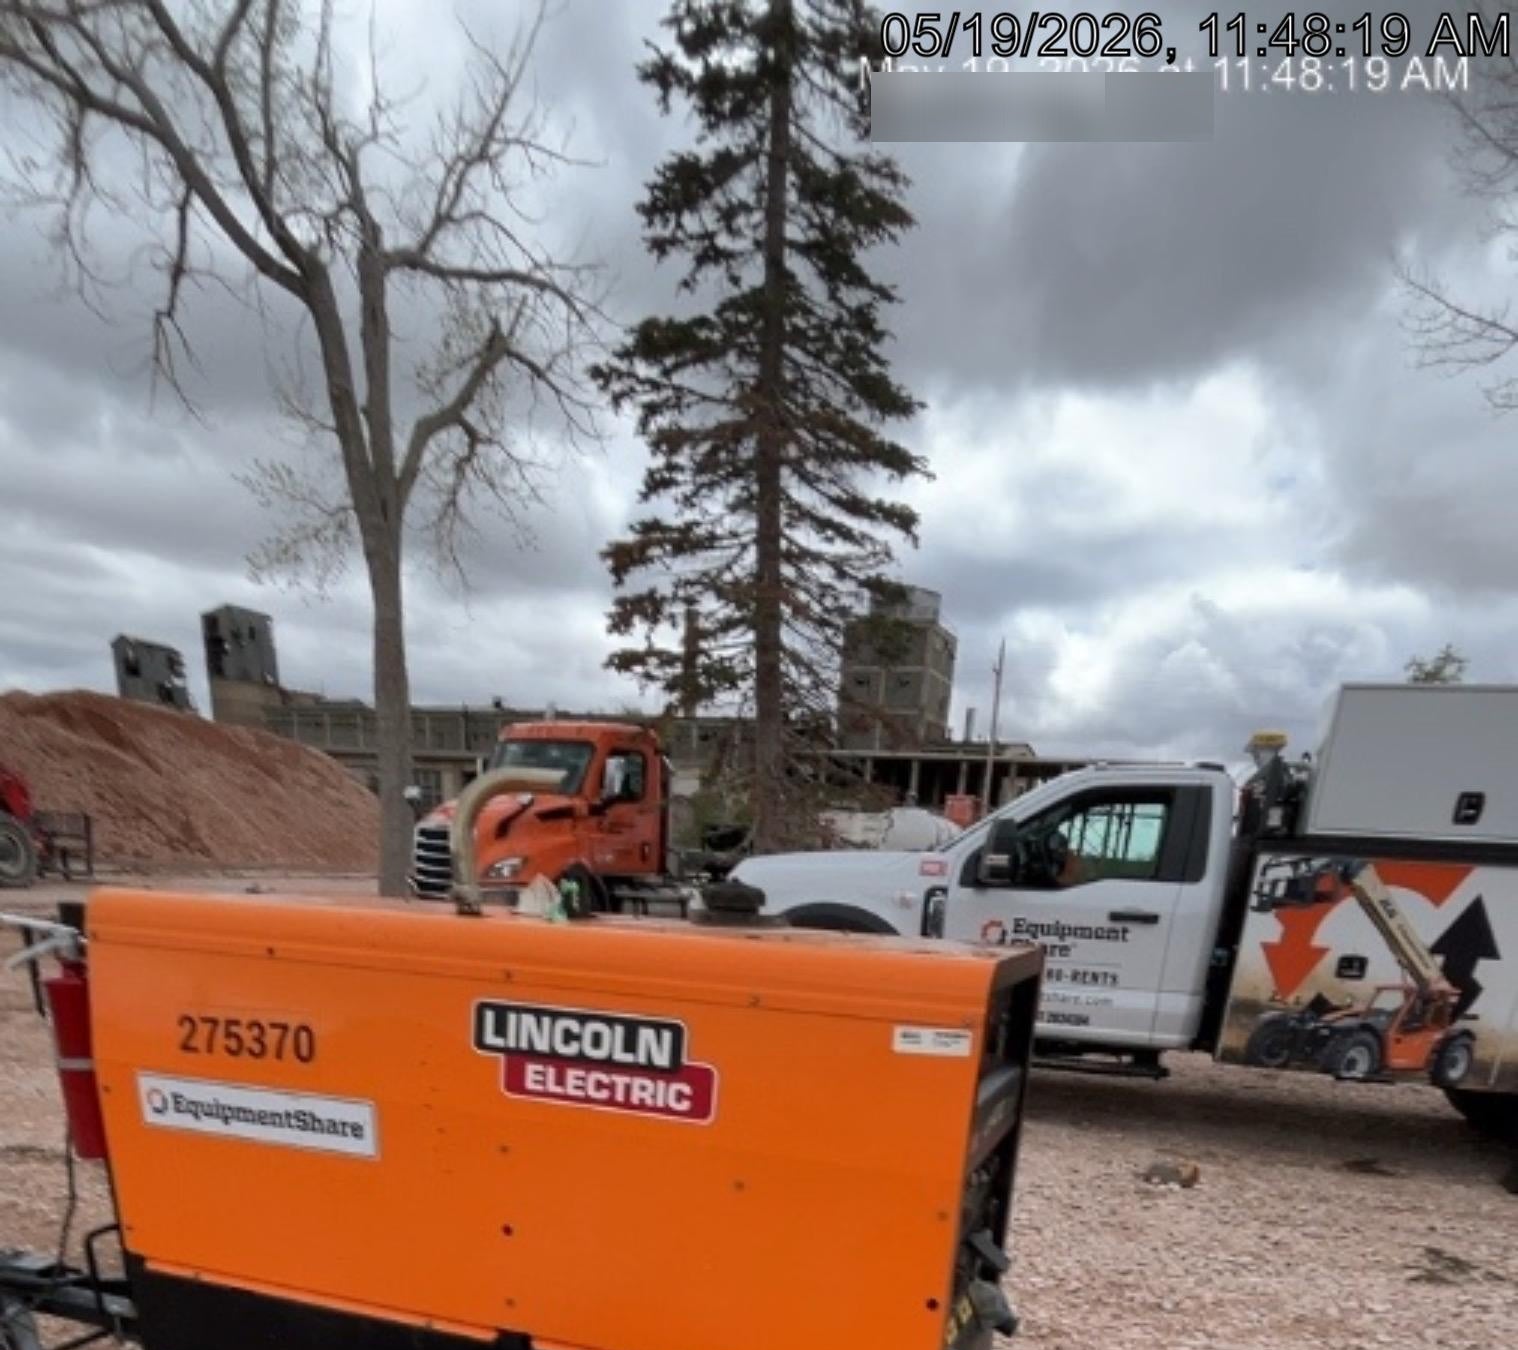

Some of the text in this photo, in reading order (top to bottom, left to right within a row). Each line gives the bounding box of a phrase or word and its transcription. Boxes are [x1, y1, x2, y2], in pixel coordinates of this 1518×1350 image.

[1012, 917, 1129, 943] Equipment
[176, 1013, 316, 1064] 275370
[482, 1008, 673, 1068] LINCOLN
[524, 1063, 694, 1113] ELECTRIC
[170, 1092, 365, 1140] EquipmentShare
